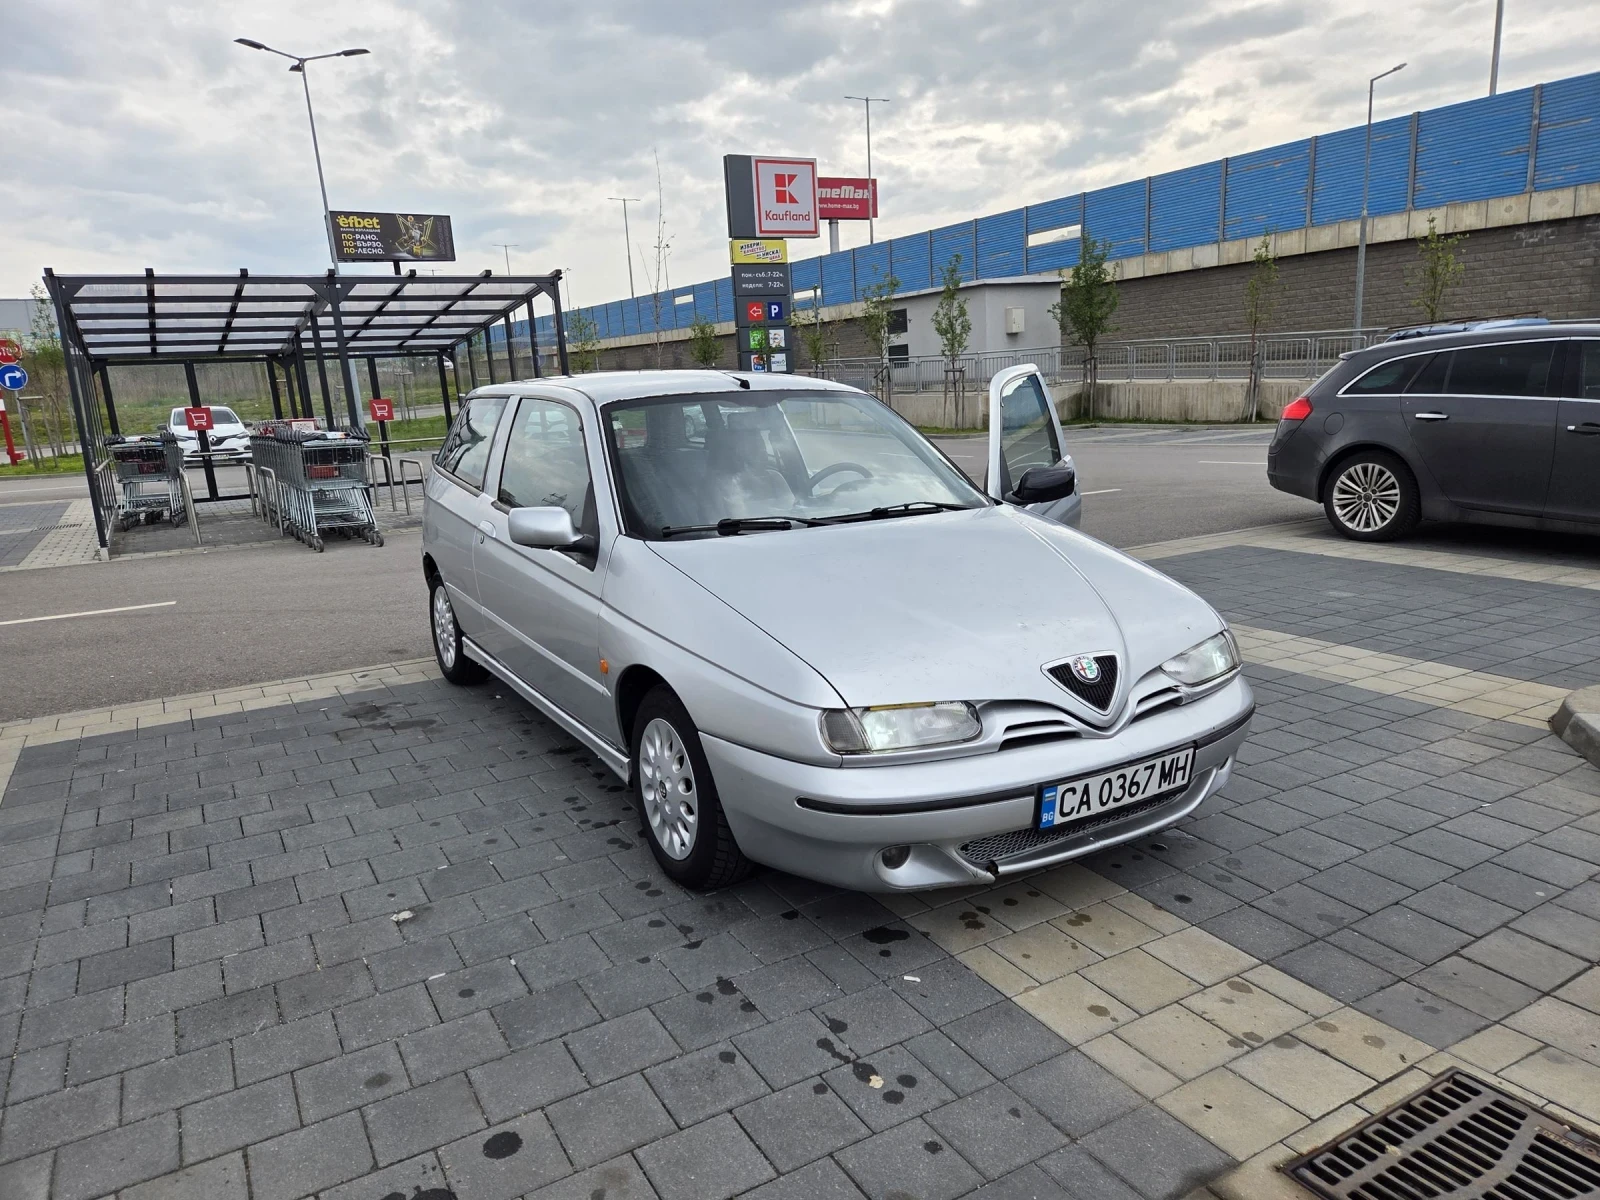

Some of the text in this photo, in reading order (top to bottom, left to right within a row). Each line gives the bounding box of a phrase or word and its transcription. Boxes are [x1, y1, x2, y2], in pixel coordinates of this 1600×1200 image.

[818, 185, 872, 199] meMax
[819, 202, 860, 211] ww.home-max.bg
[337, 215, 380, 229] efbet
[765, 210, 811, 222] Kaufland
[343, 240, 384, 248] ПО-БЪРЗО.
[344, 247, 385, 255] ПО-ЛЕСНО.
[771, 304, 779, 317] P
[1058, 753, 1190, 818] CA 0367 MH
[1042, 811, 1054, 823] BG
